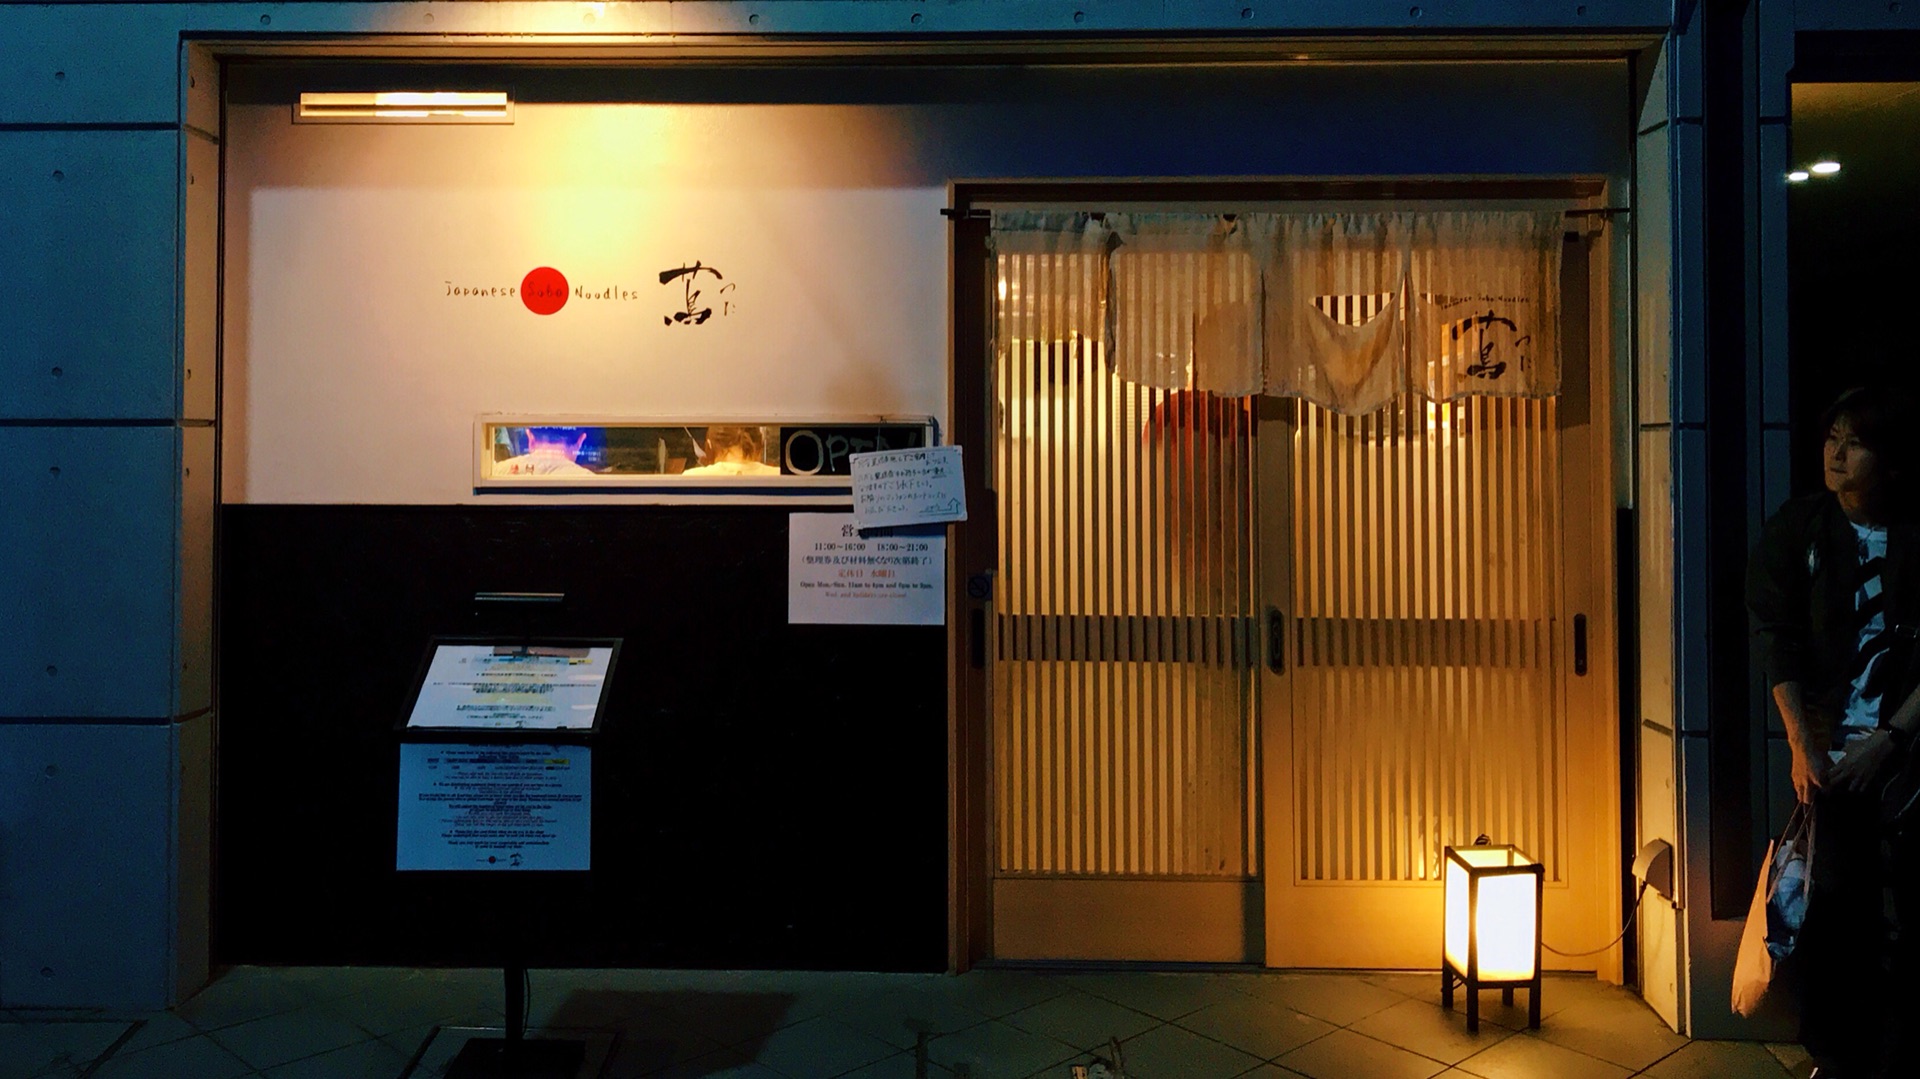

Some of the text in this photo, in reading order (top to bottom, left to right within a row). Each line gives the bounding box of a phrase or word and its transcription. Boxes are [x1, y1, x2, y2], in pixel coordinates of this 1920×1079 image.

[444, 281, 516, 297] Japanese
[575, 284, 638, 300] Noodles
[800, 581, 815, 589] Open
